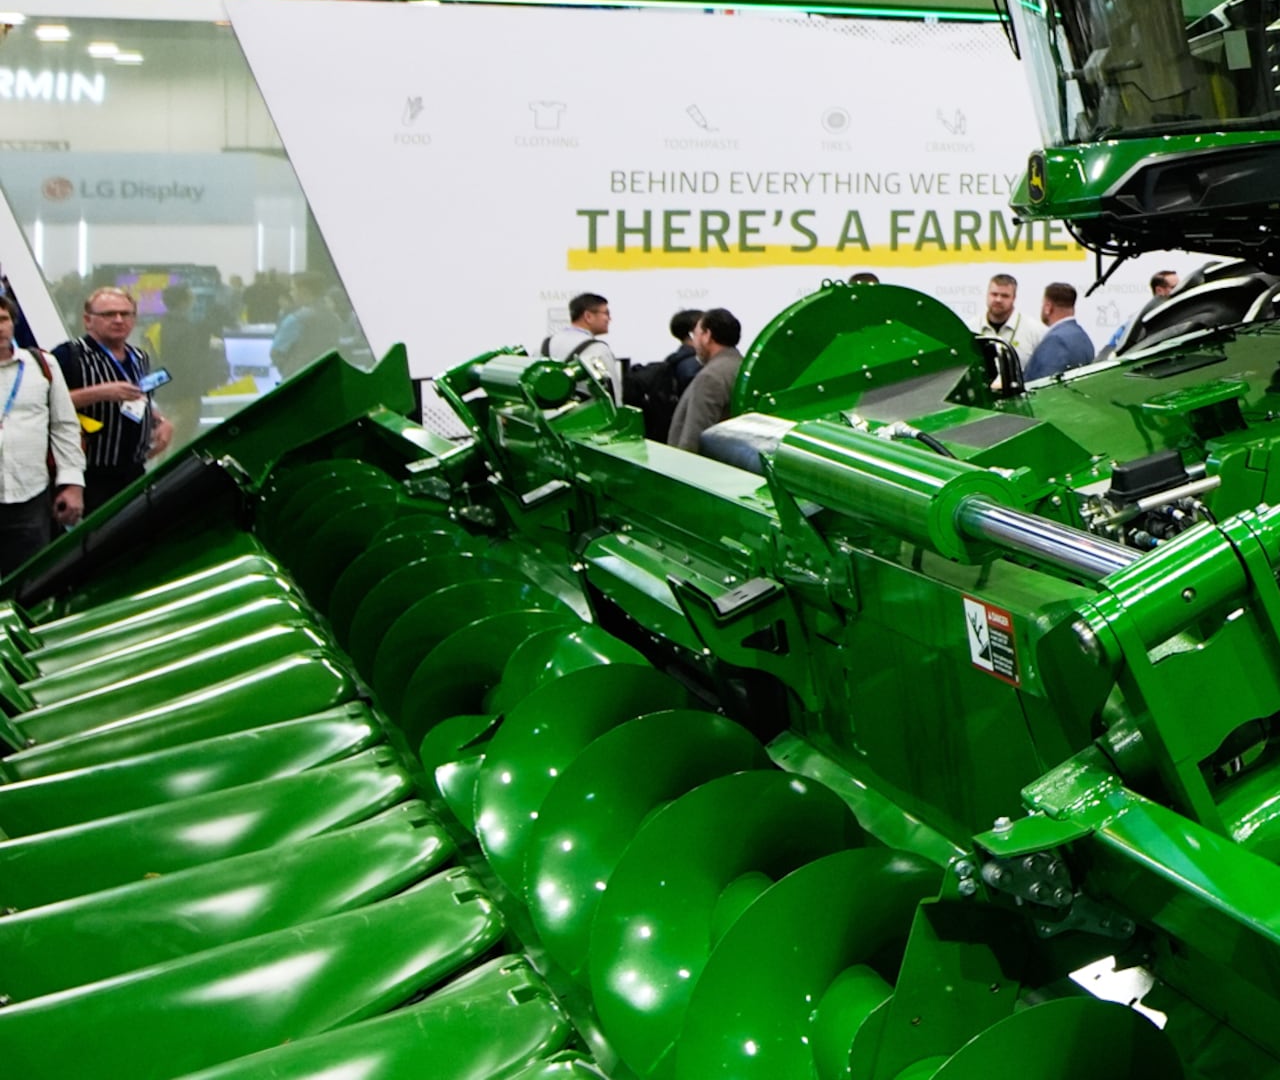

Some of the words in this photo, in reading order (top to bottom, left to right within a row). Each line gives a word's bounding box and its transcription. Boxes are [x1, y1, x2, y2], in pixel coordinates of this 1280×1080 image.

[80, 181, 114, 199] LG
[120, 180, 205, 203] Display
[610, 170, 719, 194] BEHIND
[730, 172, 900, 195] EVERYTHING
[909, 174, 950, 195] WE
[959, 174, 1018, 195] RELY
[836, 210, 870, 252] A
[890, 210, 1084, 251] FARME
